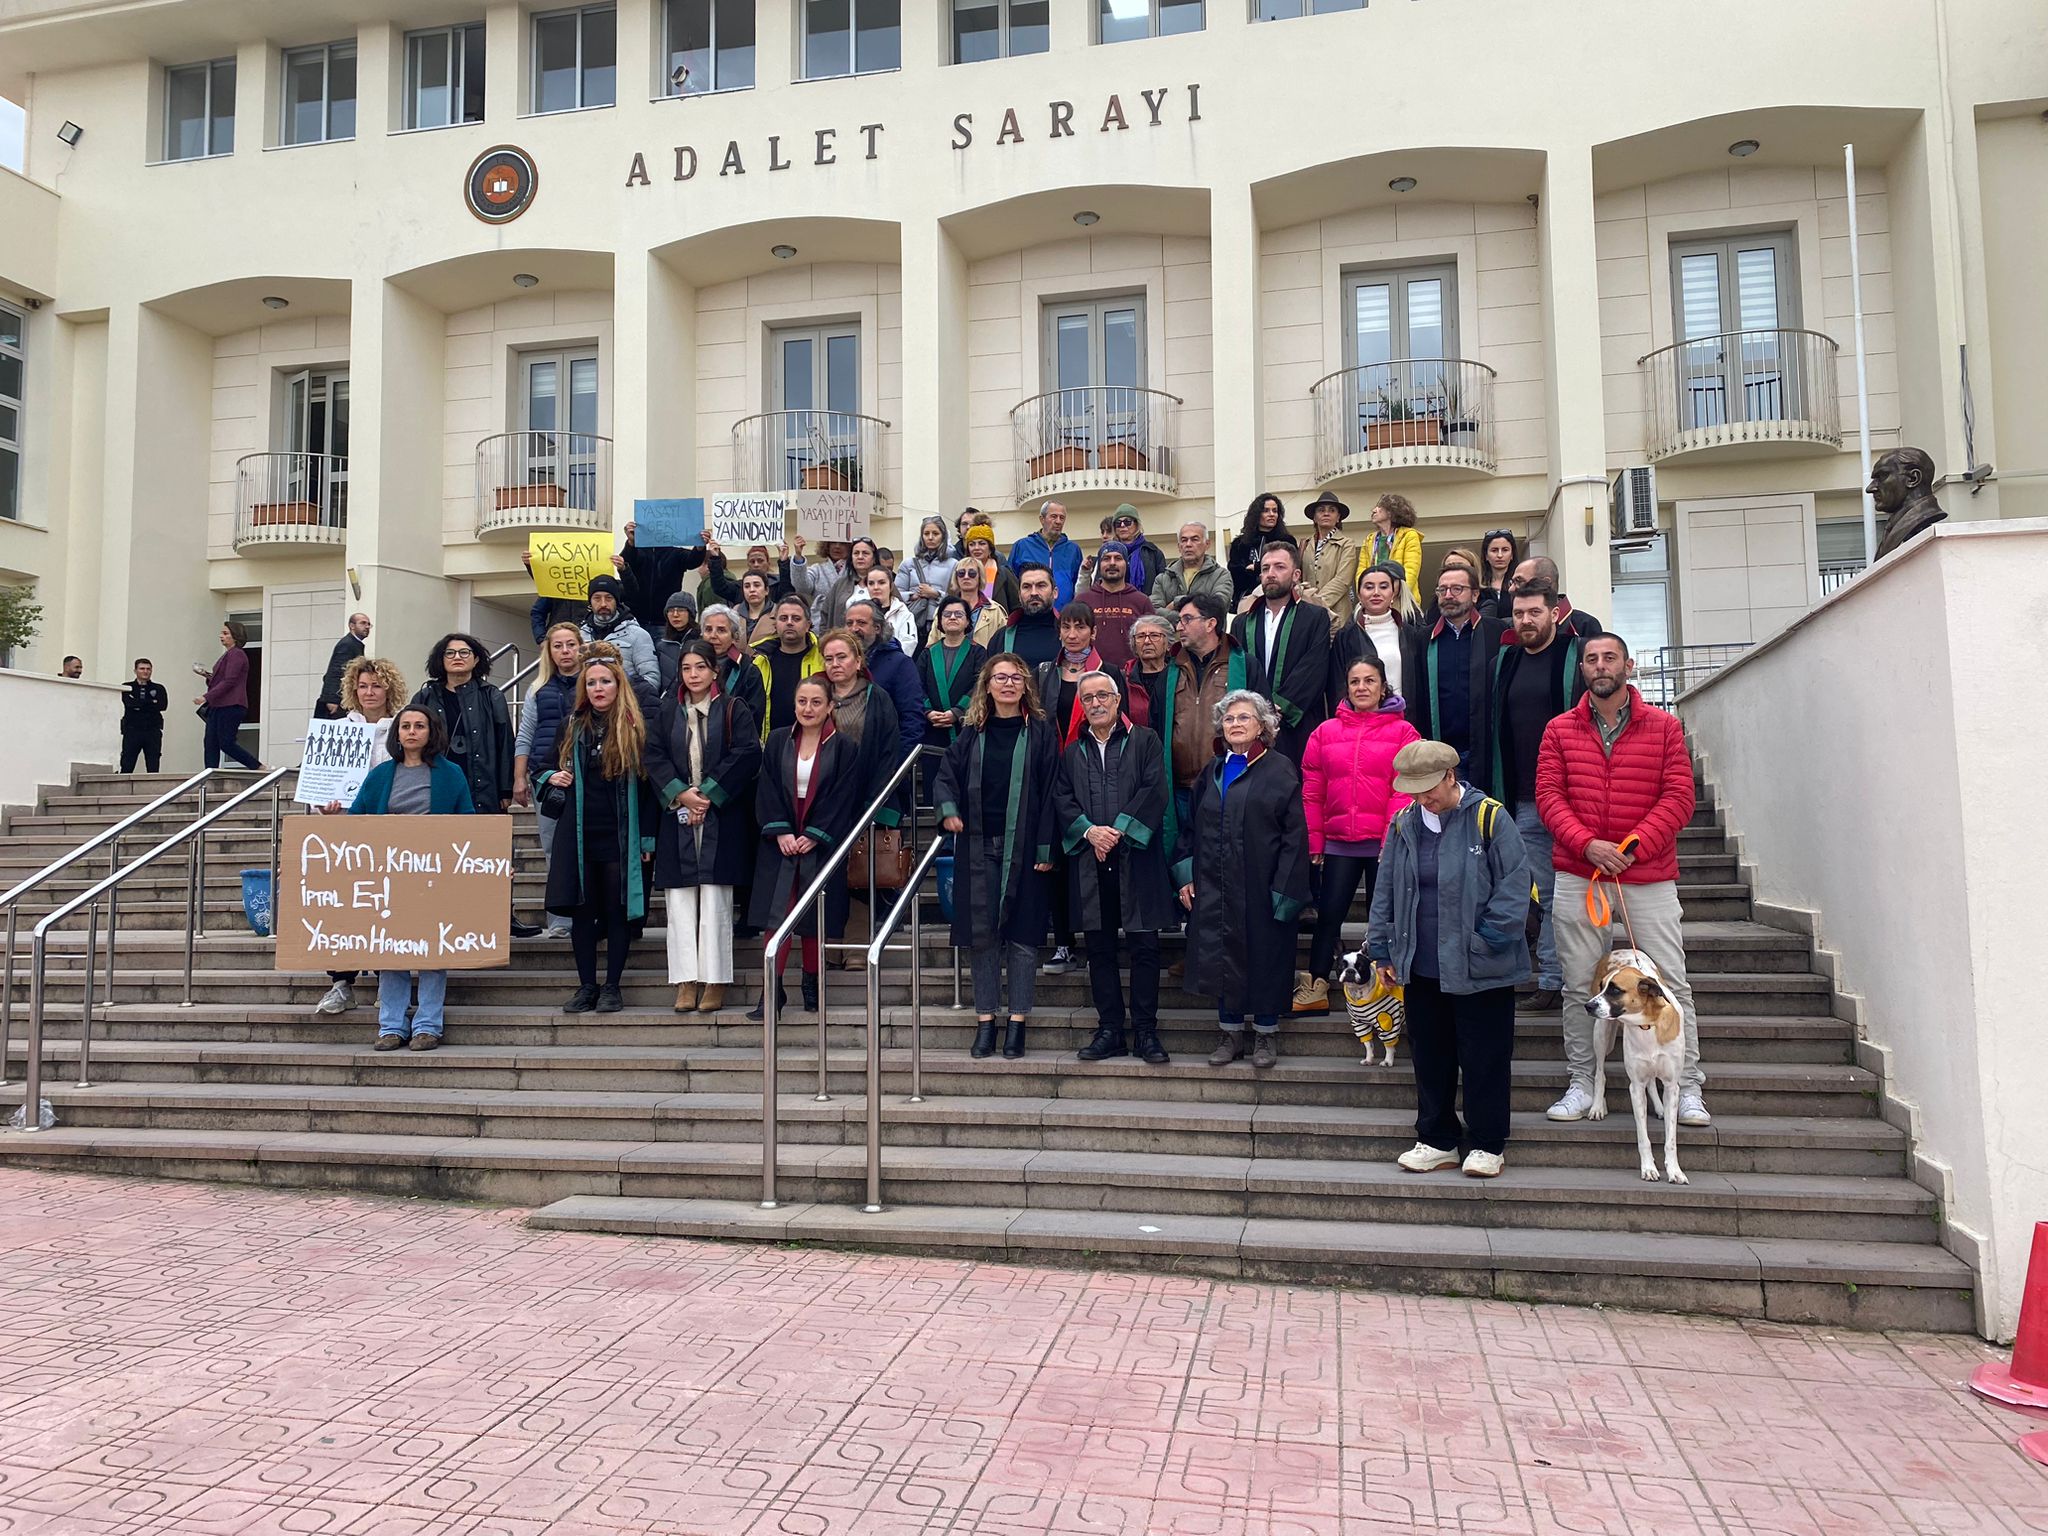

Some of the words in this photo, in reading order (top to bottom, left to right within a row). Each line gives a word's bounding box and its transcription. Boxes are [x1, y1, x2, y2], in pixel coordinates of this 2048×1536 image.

[625, 123, 885, 187] ADALET
[951, 83, 1202, 150] SARAYI
[714, 499, 784, 519] SOKAKTAYIM
[800, 507, 832, 522] YASAYI
[713, 521, 784, 541] YANINDAYIM
[537, 542, 599, 562] YASAYI
[549, 563, 591, 581] GERİ
[556, 582, 588, 596] ÇEK
[320, 724, 364, 738] ONLARA
[306, 754, 367, 768] DOKUNMA!
